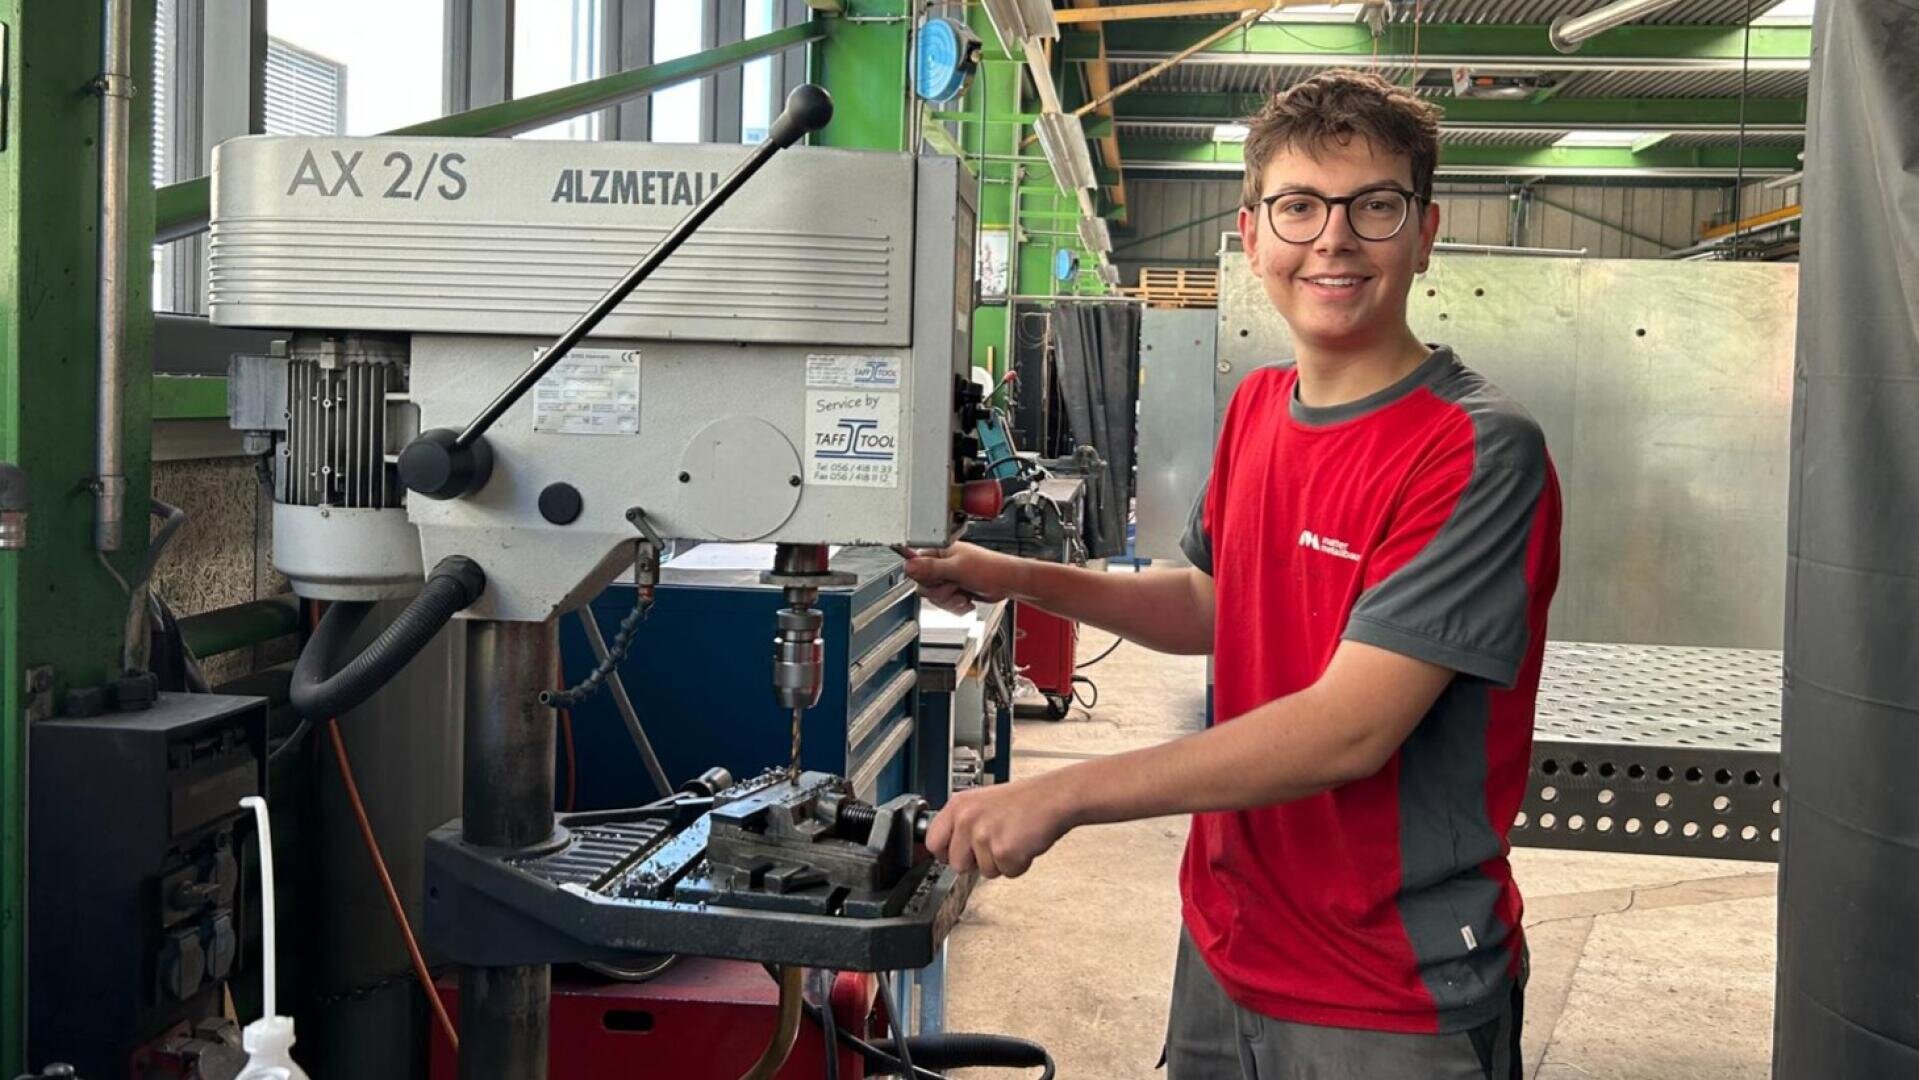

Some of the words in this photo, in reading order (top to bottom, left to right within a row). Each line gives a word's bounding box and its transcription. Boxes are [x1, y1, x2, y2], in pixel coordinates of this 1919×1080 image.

[286, 147, 364, 197] AX
[382, 151, 467, 201] 2/S
[816, 398, 862, 412] Service
[865, 394, 880, 409] by
[815, 432, 846, 445] TAFF
[861, 434, 894, 447] TOOL
